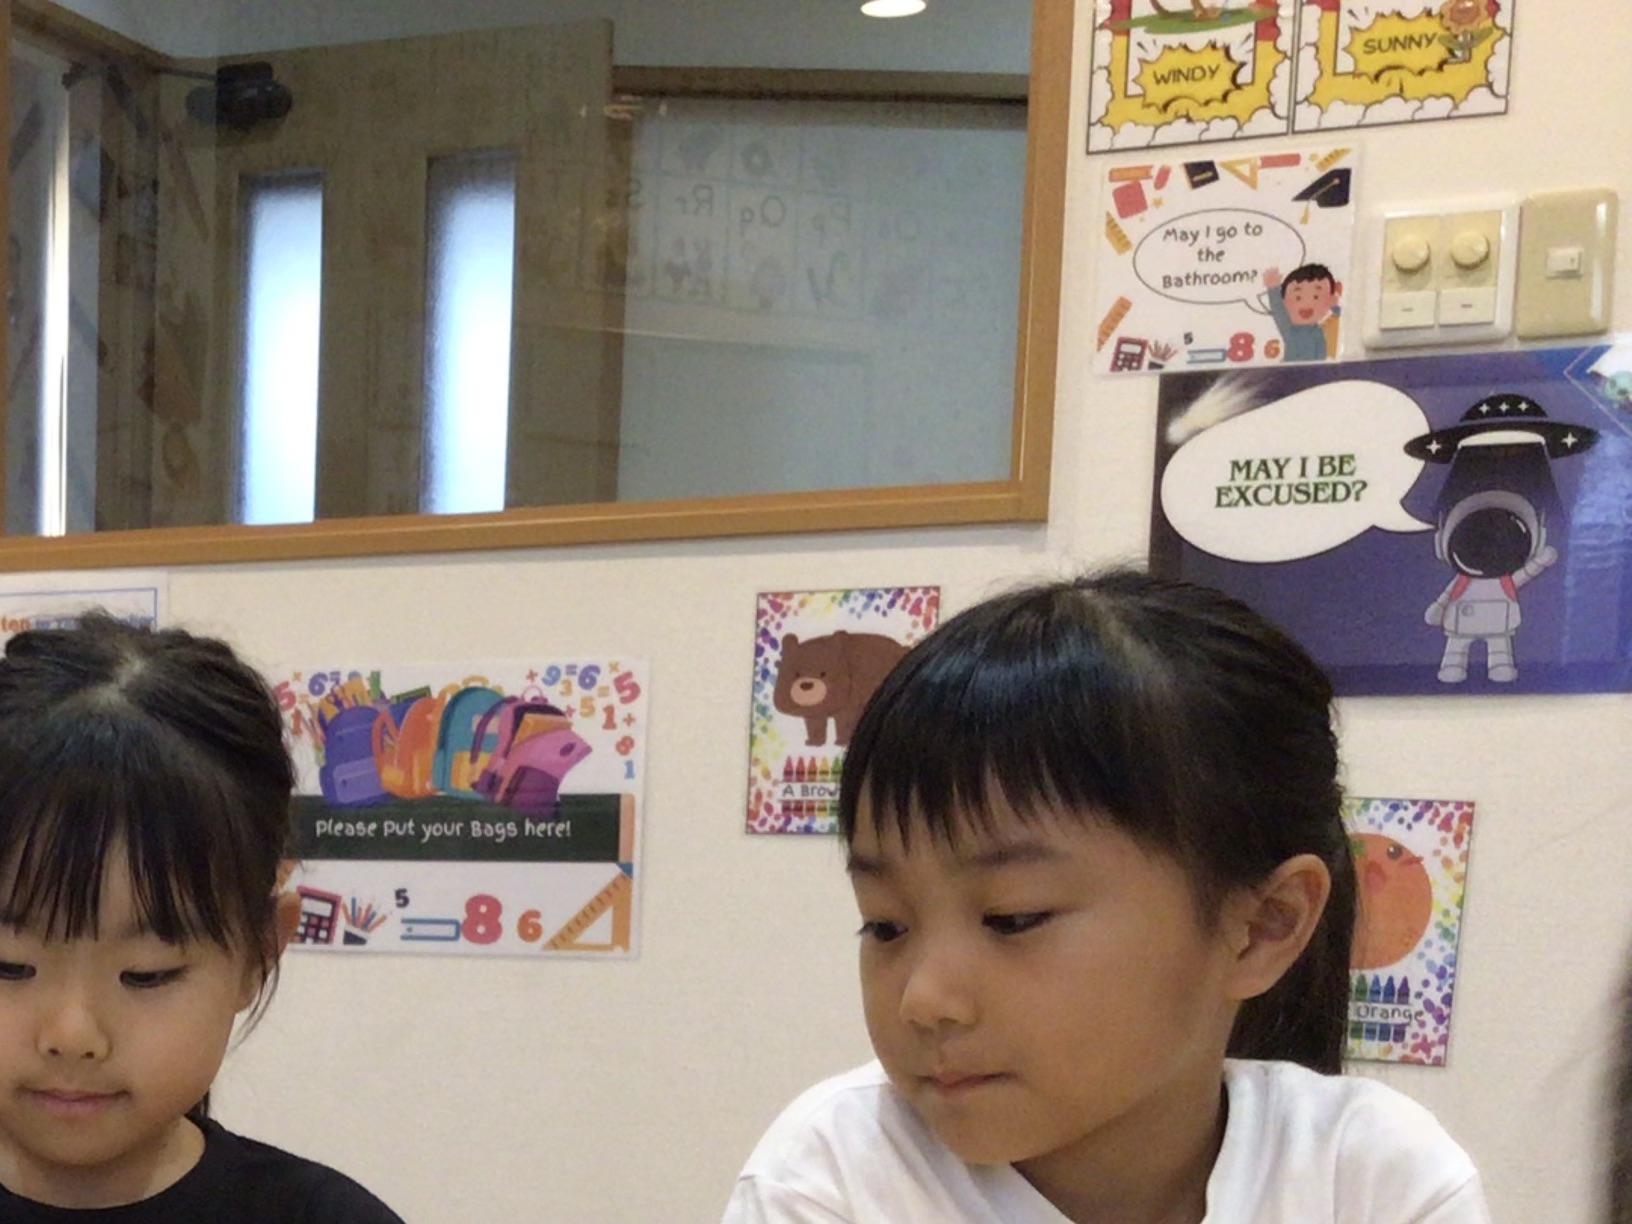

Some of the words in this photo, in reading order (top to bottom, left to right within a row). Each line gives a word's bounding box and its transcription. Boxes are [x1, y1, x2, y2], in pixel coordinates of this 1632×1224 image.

[1363, 32, 1437, 55] SUNNY
[1153, 64, 1219, 85] WINDY
[1163, 228, 1199, 247] May
[1205, 225, 1211, 238] I
[1216, 226, 1237, 243] go
[1244, 222, 1263, 238] to
[1197, 248, 1225, 262] the
[1162, 269, 1258, 289] Bathroom?
[1226, 332, 1255, 362] 8
[1264, 339, 1280, 359] 6
[1229, 457, 1292, 482] MAY
[1299, 456, 1309, 478] I
[1316, 453, 1357, 477] BE
[1215, 480, 1368, 508] EXCUSED?
[309, 672, 328, 697] 6
[542, 665, 562, 686] 9
[578, 665, 601, 690] 6
[614, 671, 641, 704] 5
[602, 704, 617, 730] 1
[624, 760, 635, 779] 1
[782, 784, 795, 797] A
[316, 819, 377, 837] Please
[421, 821, 464, 843] your
[471, 820, 518, 843] Bags
[525, 817, 571, 838] here!
[394, 888, 409, 908] 5
[461, 894, 502, 945] 8
[518, 909, 543, 943] 6
[1357, 1004, 1424, 1027] Orange
